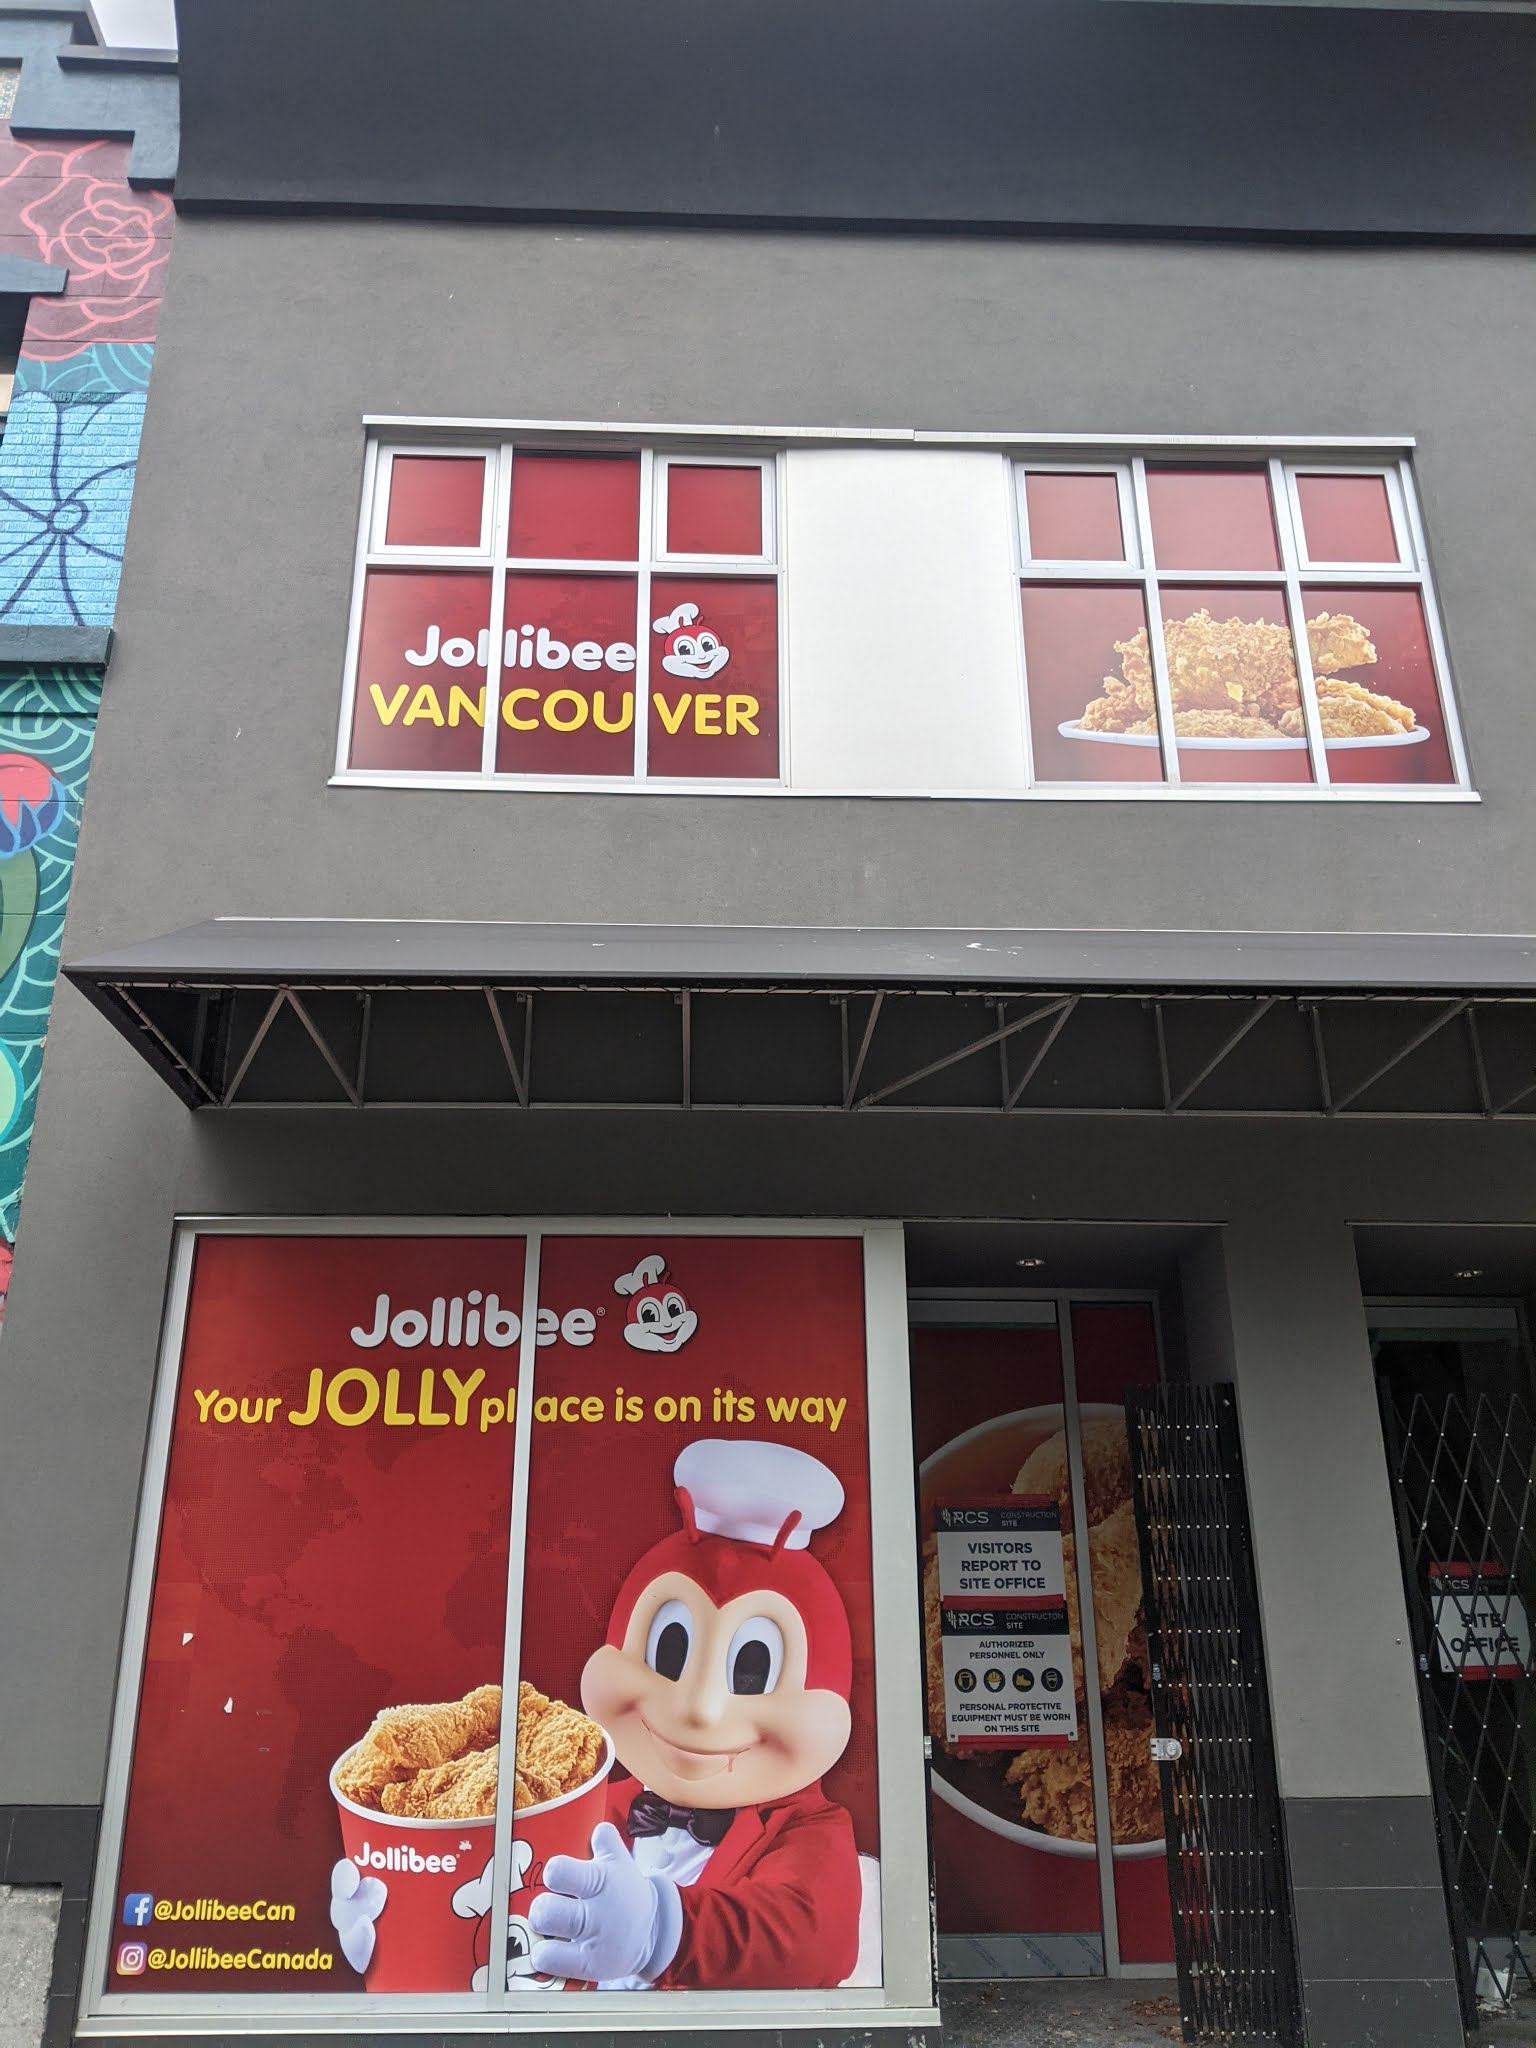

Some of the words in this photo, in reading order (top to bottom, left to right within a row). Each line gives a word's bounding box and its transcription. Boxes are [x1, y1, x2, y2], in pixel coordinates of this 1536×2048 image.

[405, 624, 637, 672] Jollibee
[369, 683, 760, 736] VANCOUVER
[193, 1389, 282, 1423] Your
[288, 1368, 486, 1426] JOLLY
[614, 1387, 644, 1422] is
[654, 1396, 701, 1422] on
[713, 1387, 755, 1422] its
[766, 1396, 847, 1432] way
[953, 1511, 989, 1524] RCS
[967, 1542, 1032, 1554] VISITORS
[961, 1561, 1018, 1572] REPORT
[1021, 1560, 1041, 1571] TO
[959, 1578, 990, 1589] SITE
[994, 1577, 1045, 1589] OFFICE
[958, 1613, 995, 1626] RCS
[1023, 1651, 1045, 1659] ONLY
[959, 1703, 1006, 1711] PERSONAL
[951, 1714, 1002, 1722] EQUIPMENT
[1043, 1713, 1071, 1721] WORN
[984, 1725, 997, 1733] ON
[1021, 1724, 1040, 1732] SITE
[353, 1842, 457, 1873] Jollibee
[154, 1899, 296, 1922] @JollibeeCan
[147, 1947, 333, 1970] @JollibeeCanada
